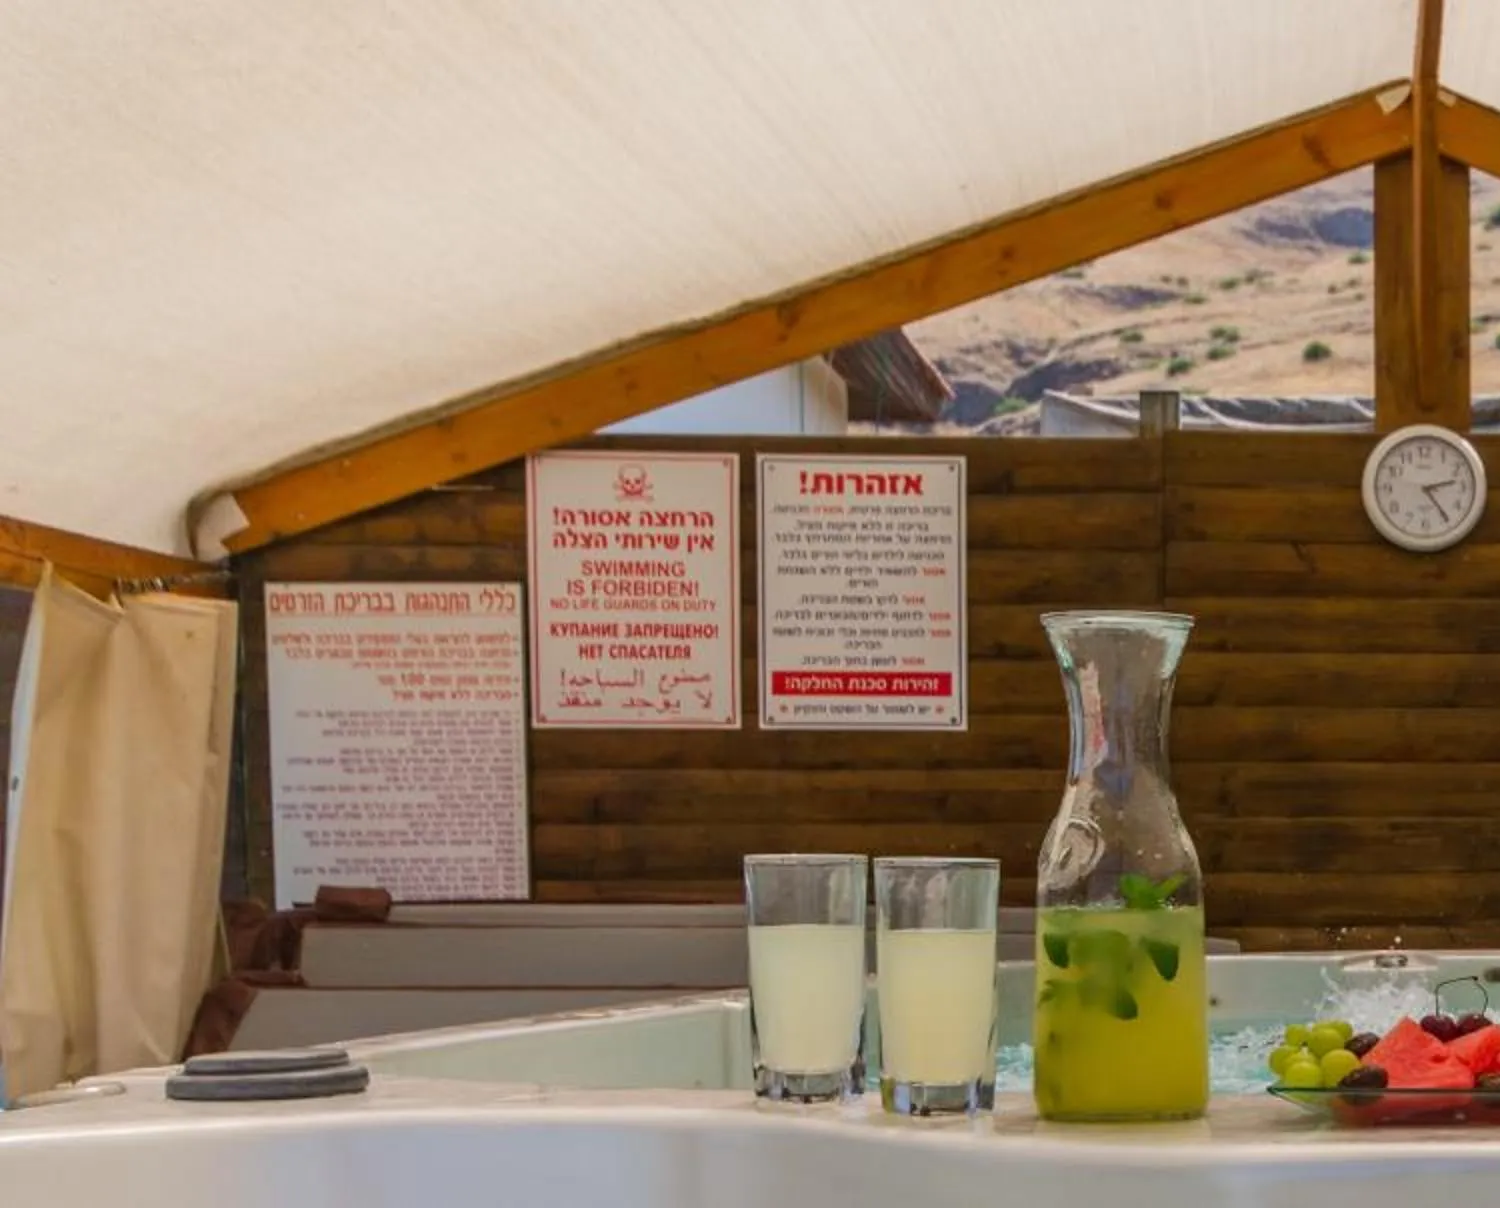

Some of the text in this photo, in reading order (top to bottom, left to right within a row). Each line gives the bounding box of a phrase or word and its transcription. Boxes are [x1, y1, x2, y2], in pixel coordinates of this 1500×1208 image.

[1418, 446, 1431, 457] 12
[800, 470, 923, 495] אזהרות!
[554, 507, 714, 527] הרחצה אסורה!
[553, 530, 714, 553] אין שירותי הצלה
[582, 560, 685, 577] SWIMMING
[568, 580, 699, 597] IS FORBIDEN!
[335, 592, 394, 613] בבריכת
[479, 589, 515, 612] כללי
[551, 599, 717, 611] NO LIFE GUARDS ON DUTY
[550, 622, 719, 640] КУПАНИЕ ЗАПРЕЩЕНО!
[579, 645, 691, 659] НЕТ СПАСАТЕЛЯ
[785, 675, 939, 693] זהירות סכנת החלקה!
[696, 690, 712, 709] لا
